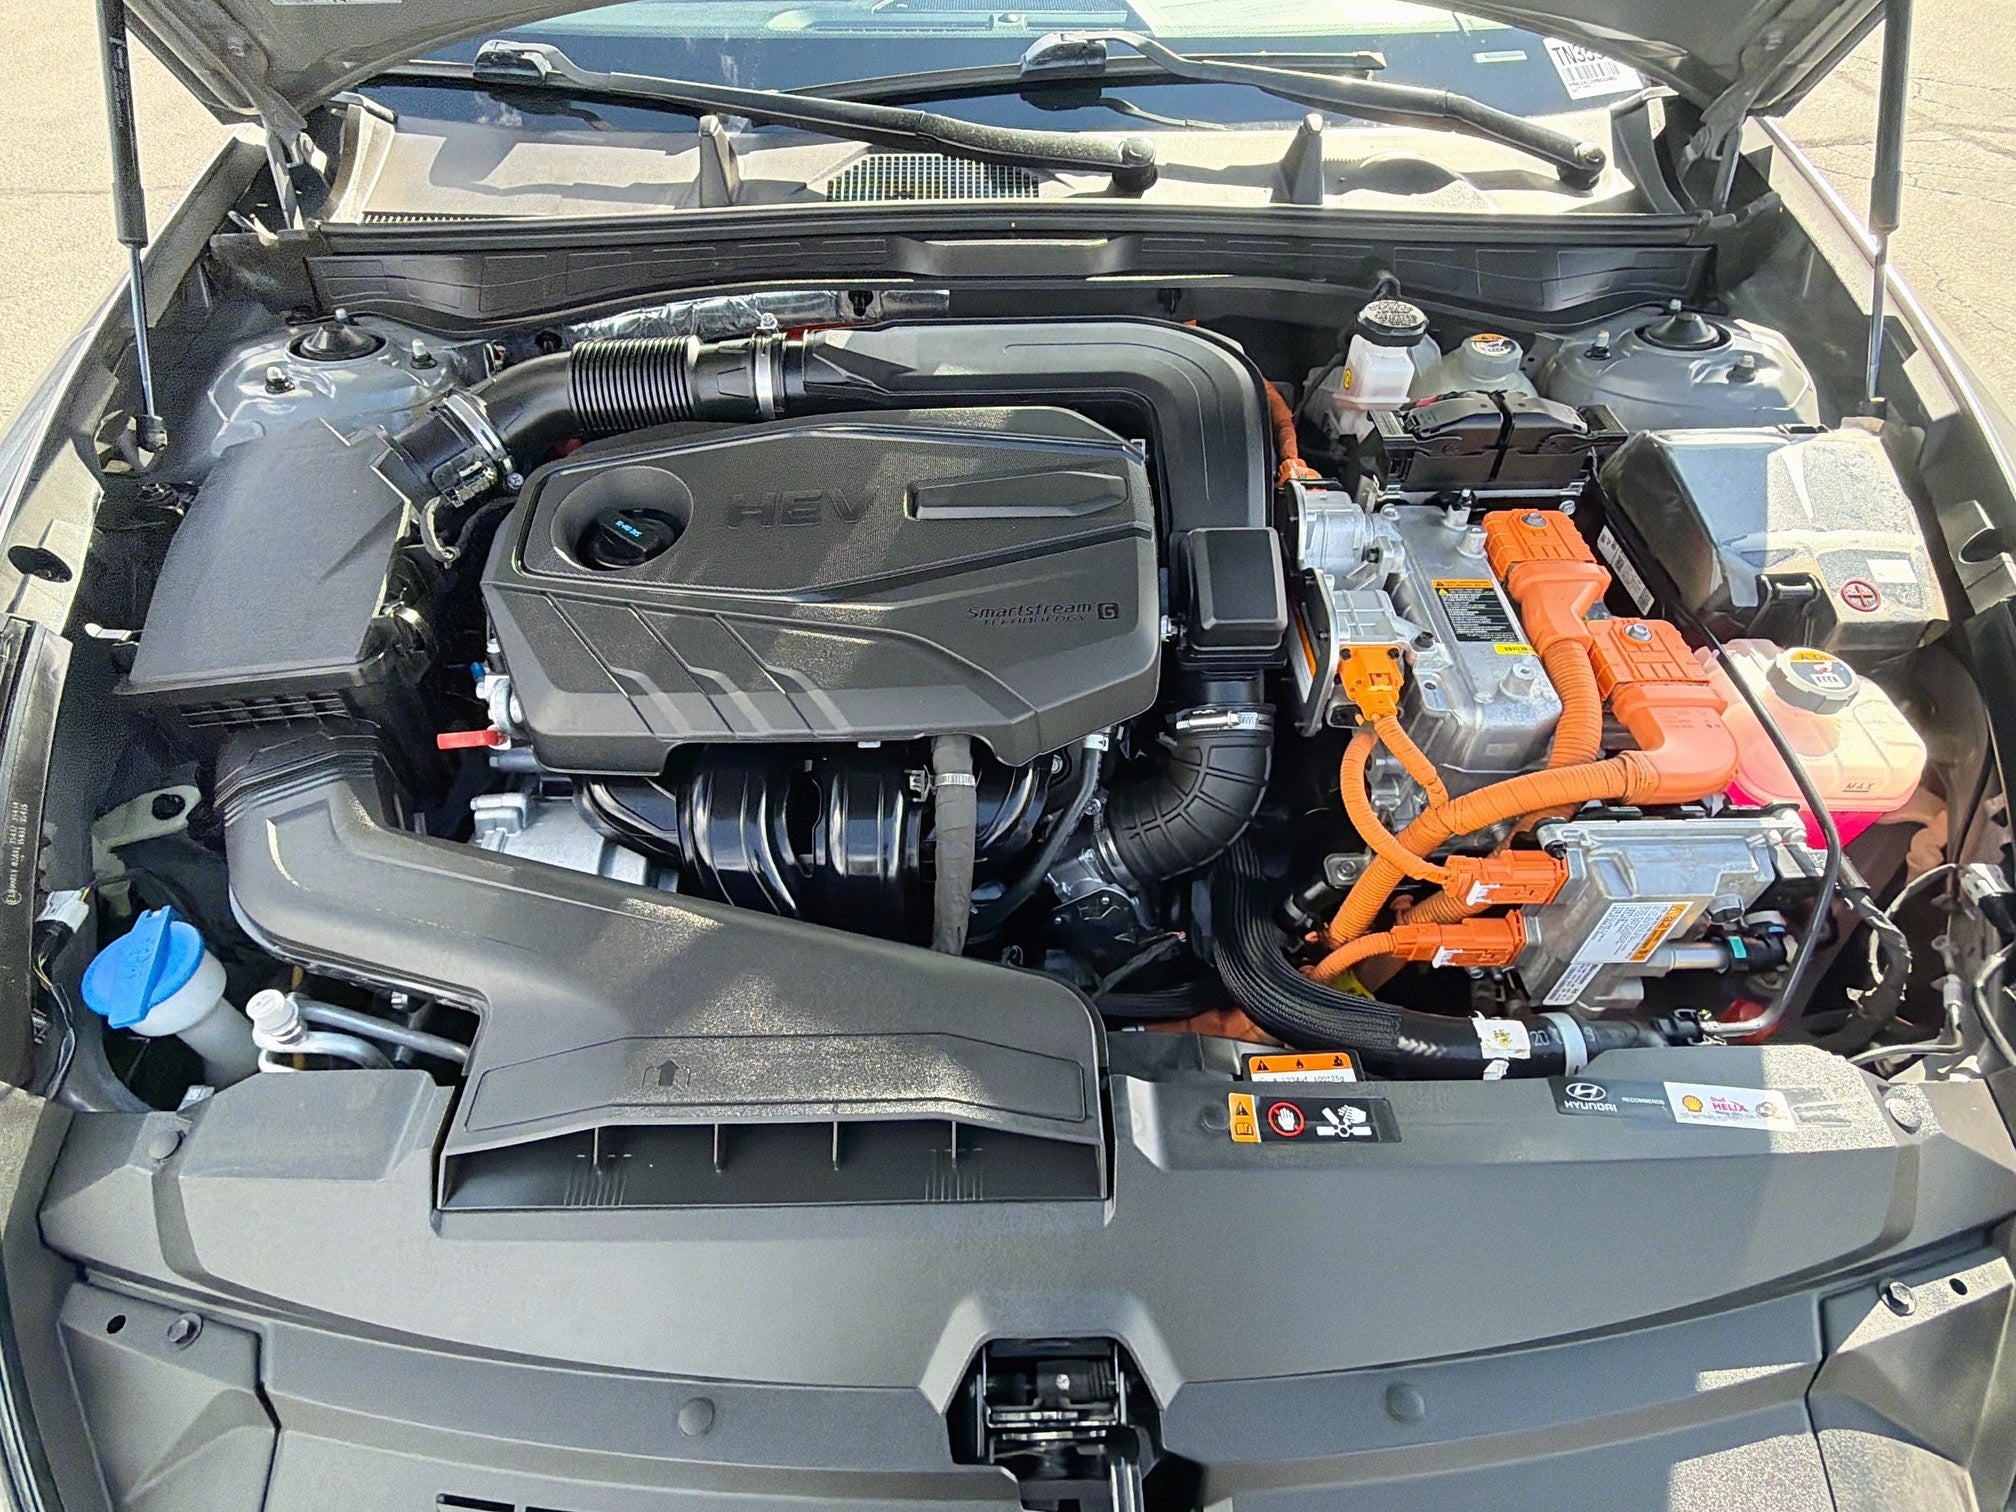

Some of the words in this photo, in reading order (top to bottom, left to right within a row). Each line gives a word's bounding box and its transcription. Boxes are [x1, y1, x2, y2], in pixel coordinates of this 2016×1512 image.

[726, 488, 879, 530] HEV
[968, 603, 1092, 619] Smartstream
[1564, 1100, 1618, 1112] HYUNDAI
[1712, 1102, 1749, 1113] HELIX
